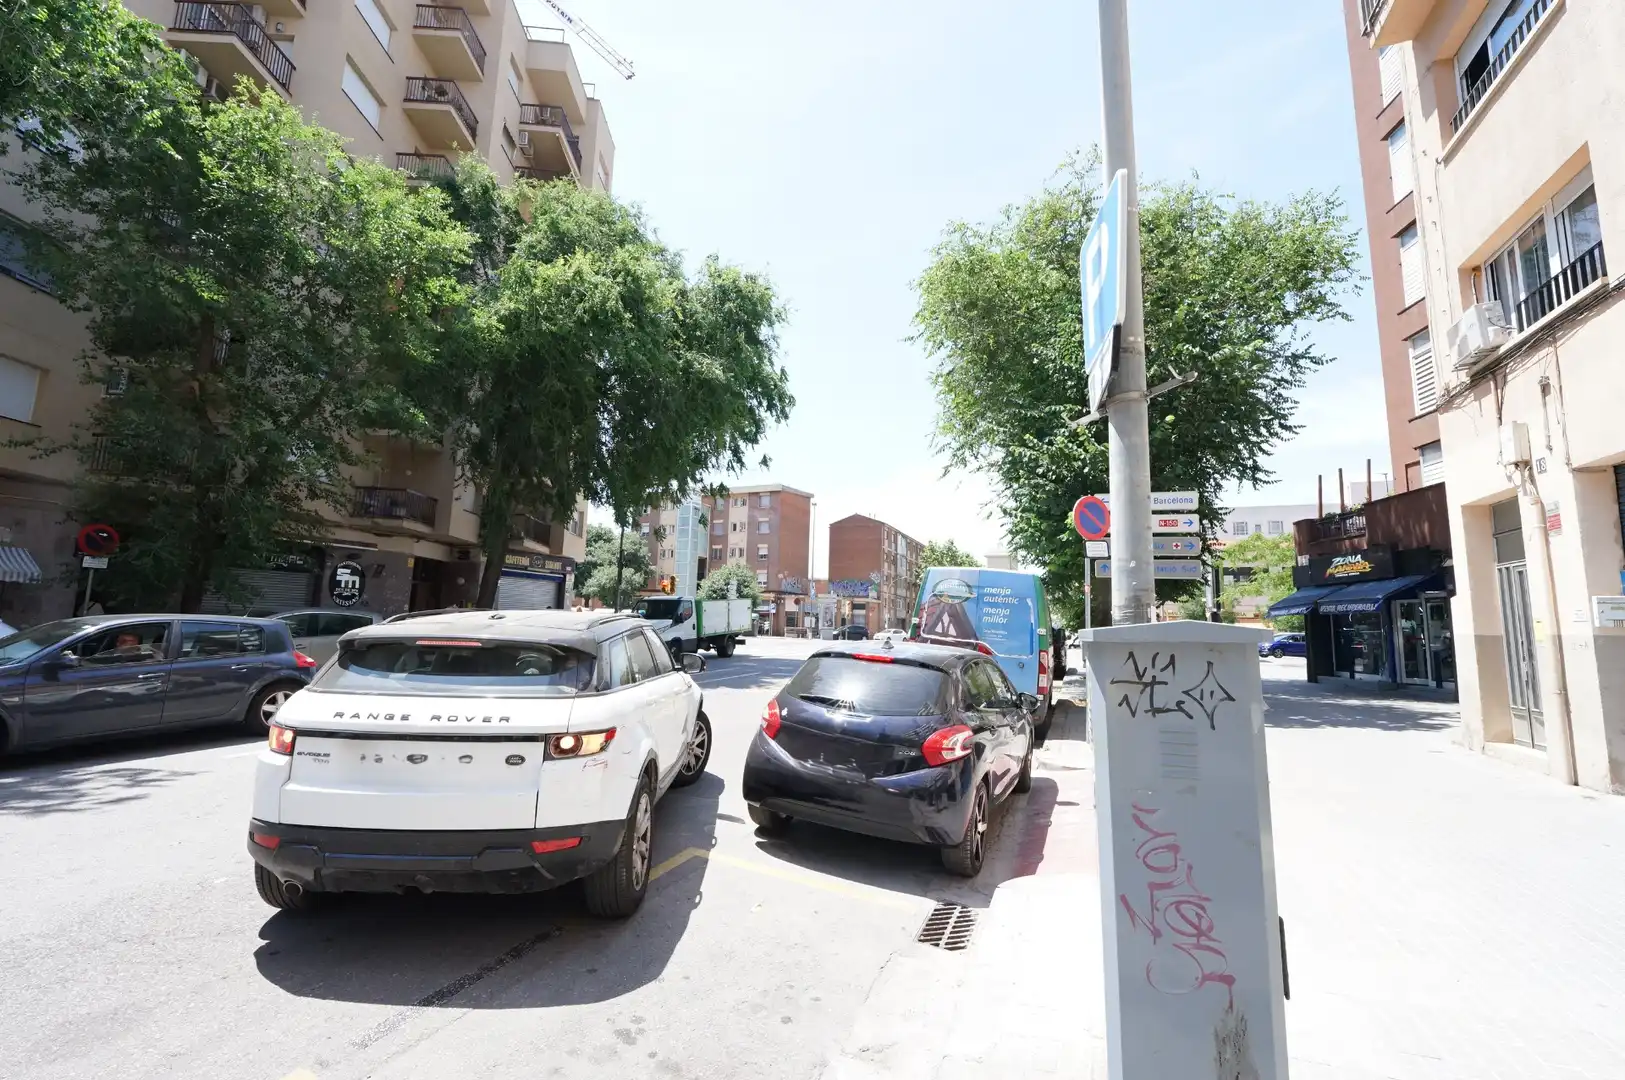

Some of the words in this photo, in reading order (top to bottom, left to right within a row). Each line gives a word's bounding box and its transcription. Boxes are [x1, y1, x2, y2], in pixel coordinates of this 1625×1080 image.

[1086, 222, 1110, 348] P
[1536, 459, 1547, 472] 18
[1153, 497, 1194, 505] Barcelona
[1159, 519, 1178, 527] N-150
[1331, 554, 1363, 568] ZONA
[984, 586, 1011, 595] menja
[983, 607, 1010, 617] menja
[983, 615, 1008, 624] millor
[333, 711, 411, 721] RANGE
[430, 714, 510, 723] ROVER
